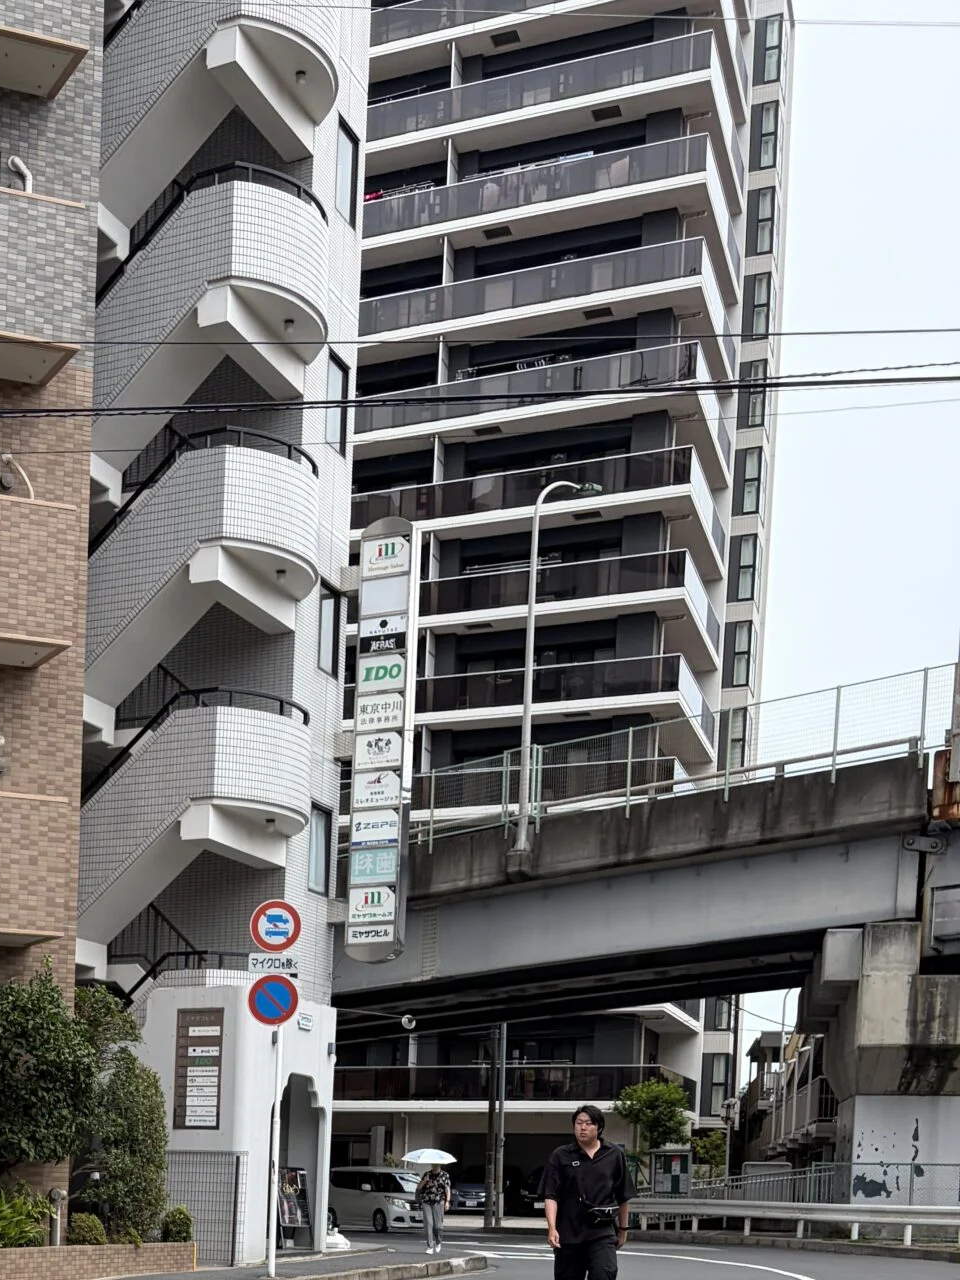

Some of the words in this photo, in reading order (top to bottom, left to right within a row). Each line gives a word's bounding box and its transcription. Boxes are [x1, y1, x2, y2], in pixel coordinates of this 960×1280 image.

[362, 663, 402, 682] IDO
[359, 700, 402, 716] 東京中川
[351, 929, 391, 939] ミヤサワビル
[251, 957, 298, 970] マイクロを除く
